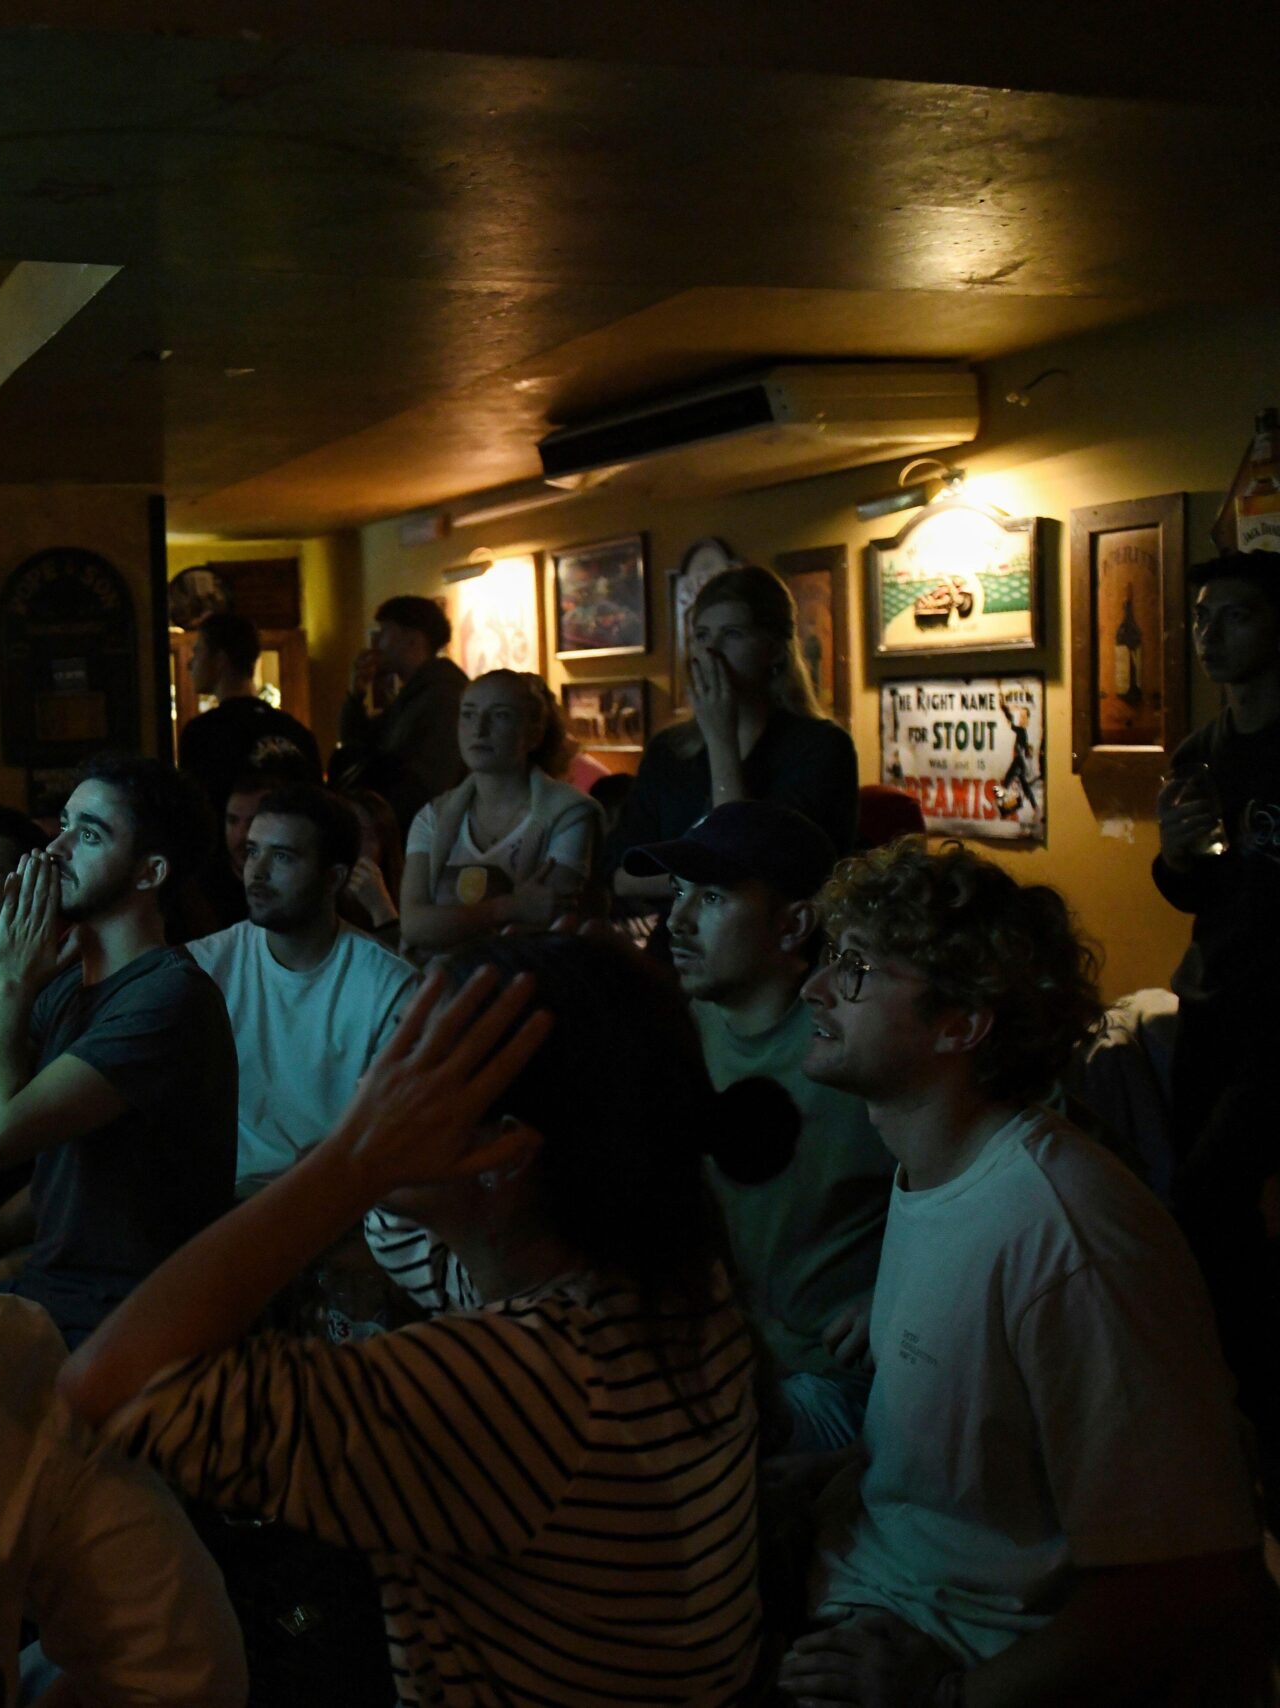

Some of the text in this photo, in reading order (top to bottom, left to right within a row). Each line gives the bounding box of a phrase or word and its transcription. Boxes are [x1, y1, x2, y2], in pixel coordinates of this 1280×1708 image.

[916, 687, 955, 712] RIGHT
[960, 692, 996, 711] NAME
[908, 721, 997, 751] FOR STOUT
[904, 776, 1019, 820] EAMIS
